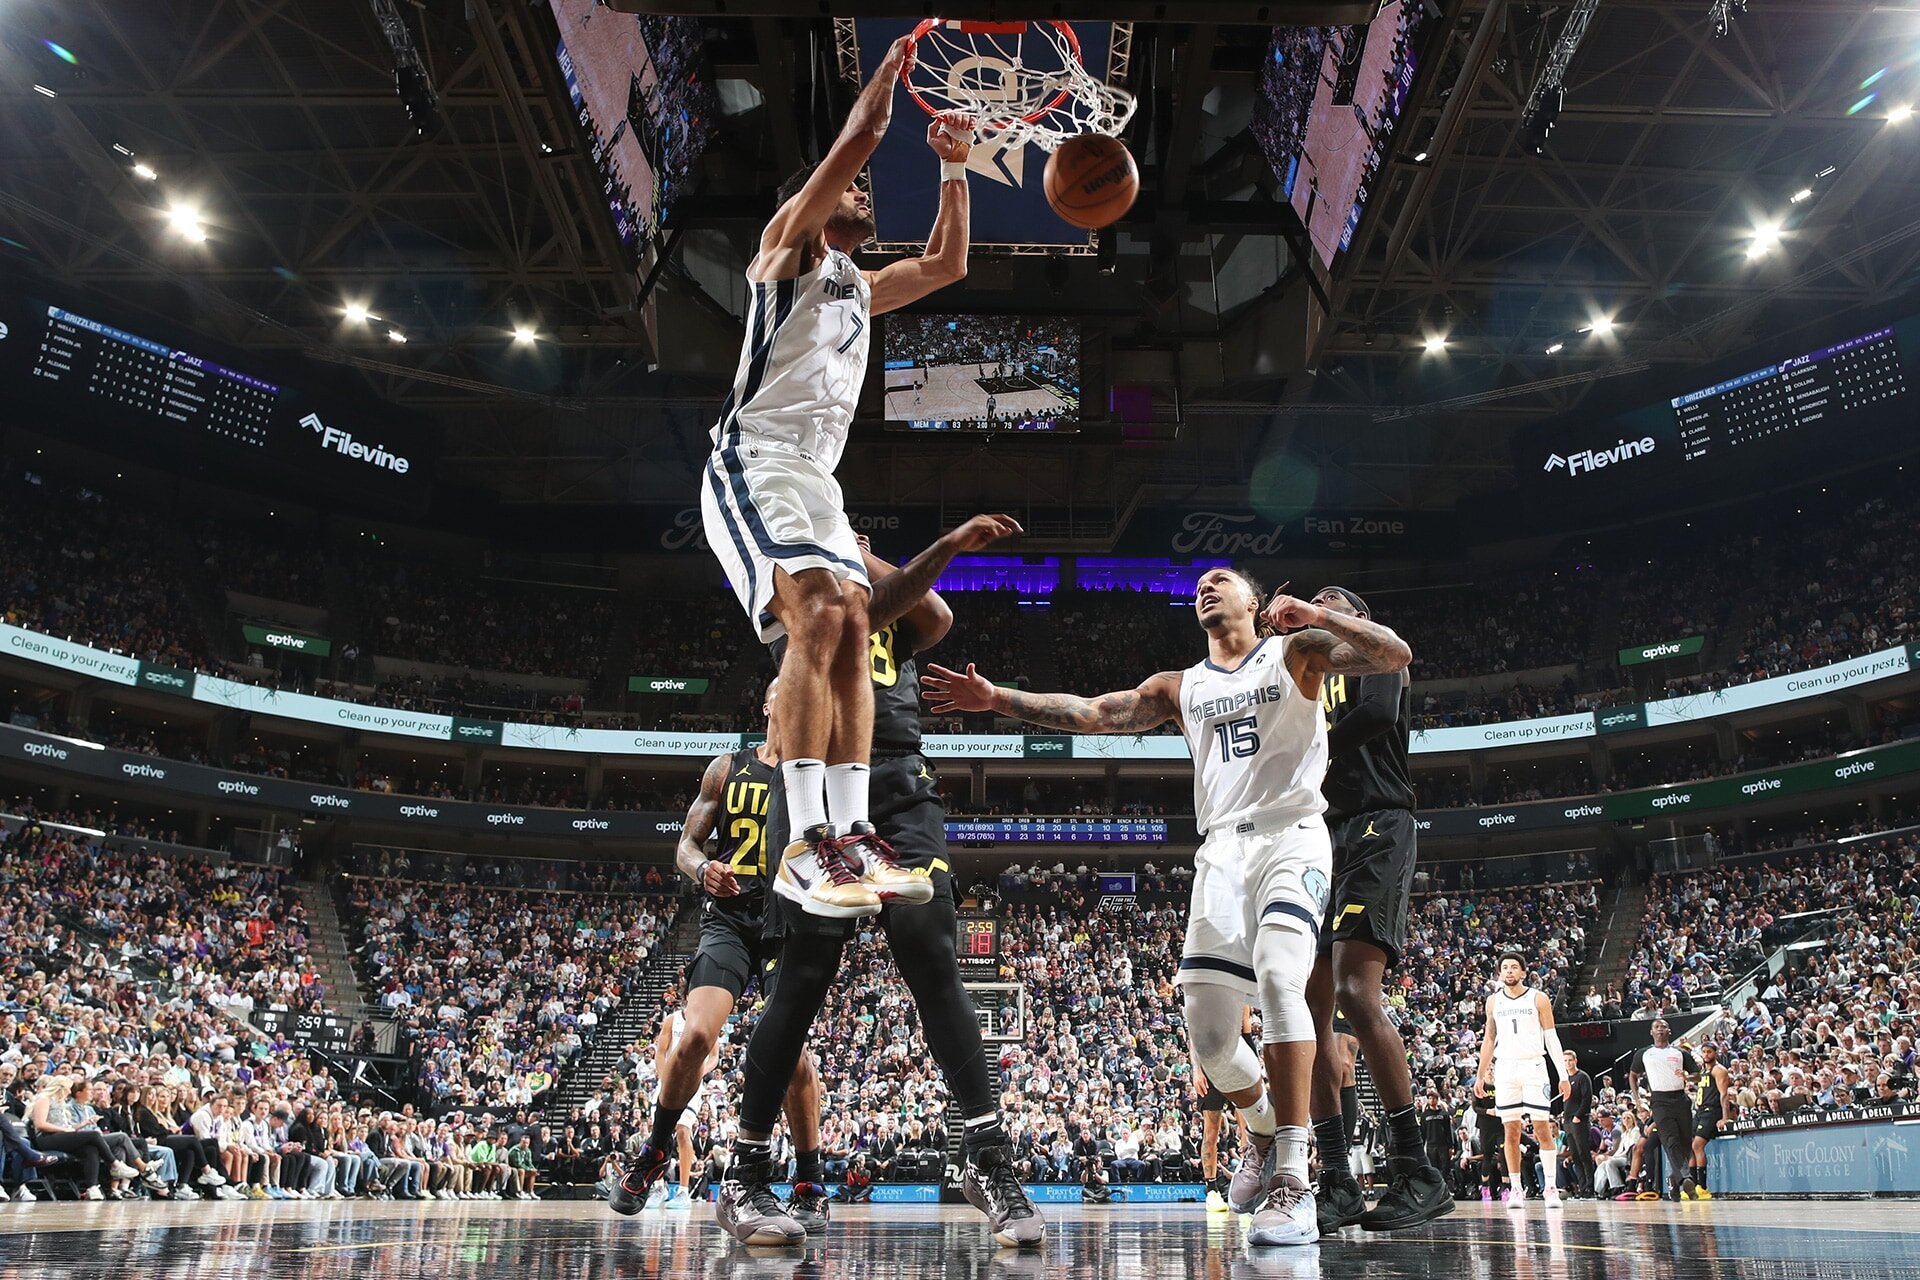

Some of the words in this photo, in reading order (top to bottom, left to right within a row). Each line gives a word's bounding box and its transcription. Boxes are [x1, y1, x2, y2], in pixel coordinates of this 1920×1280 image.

[1383, 117, 1394, 135] 79
[1358, 185, 1369, 202] 83
[57, 323, 76, 334] WELLS
[64, 313, 102, 332] GRIZZLIES
[837, 311, 864, 354] 7
[50, 347, 72, 358] CLARKE
[47, 360, 71, 371] ALDAMA
[185, 355, 203, 367] JAZZ
[1792, 355, 1810, 367] JAZZ
[1790, 365, 1818, 377] CLARKSON
[1793, 378, 1815, 389] COLLINS
[1684, 386, 1716, 403] GRIZZLIES
[1796, 385, 1830, 400] SENSABAUGH
[1683, 404, 1699, 413] WELLS
[1799, 398, 1828, 411] HENDRICKS
[1037, 421, 1050, 429] UTA
[1685, 415, 1702, 424] PIPPEN
[1802, 412, 1823, 423] GEORGE
[1688, 425, 1706, 435] CLARKE
[1691, 436, 1711, 446] ALDAMA
[321, 426, 409, 474] Filevine
[1567, 435, 1656, 477] Filevine
[1171, 511, 1285, 555] Ford
[1304, 517, 1344, 534] Fan
[1350, 517, 1404, 534] Zone
[266, 633, 306, 649] aptive
[10, 635, 50, 655] Clean
[51, 646, 69, 661] up
[71, 652, 99, 669] your
[100, 660, 126, 676] pest
[1642, 643, 1681, 659] aptive
[146, 670, 185, 688] aptive
[1787, 676, 1823, 692] Clean
[1825, 672, 1840, 685] up
[1842, 665, 1869, 681] your
[1871, 658, 1895, 674] pest
[650, 678, 686, 692] aptive
[1191, 685, 1281, 724] MEMPHIS
[338, 708, 370, 722] Clean
[373, 715, 389, 729] up
[390, 719, 416, 732] your
[418, 722, 440, 735] pest
[1601, 713, 1637, 728] aptive
[459, 724, 494, 738] aptive
[1484, 729, 1516, 741] Clean
[1519, 727, 1533, 740] up
[1535, 724, 1560, 738] your
[1562, 722, 1584, 734] pest
[634, 737, 665, 748] Clean
[667, 739, 682, 752] up
[683, 740, 707, 752] your
[709, 742, 730, 751] pest
[1214, 715, 1260, 763] 15
[23, 741, 68, 760] aptive
[951, 743, 965, 754] up
[967, 743, 991, 754] your
[992, 743, 1013, 752] pest
[1030, 742, 1064, 752] aptive
[122, 762, 165, 779] aptive
[1834, 760, 1876, 780] aptive
[217, 780, 259, 796] aptive
[1741, 778, 1783, 796] aptive
[310, 794, 350, 808] aptive
[1651, 793, 1692, 809] aptive
[399, 804, 440, 818] aptive
[1564, 804, 1603, 820] aptive
[486, 812, 525, 826] aptive
[572, 818, 609, 831] aptive
[655, 820, 686, 833] aptiv
[1478, 814, 1517, 829] aptive
[958, 824, 974, 832] 11/16
[975, 824, 994, 832] (69%)
[1003, 824, 1011, 832] 10
[1020, 824, 1028, 832] 18
[1036, 824, 1045, 832] 28
[1052, 824, 1062, 832] 20
[1071, 824, 1076, 832] 6
[1087, 824, 1093, 832] 3
[1103, 824, 1111, 832] 10
[1120, 824, 1129, 832] 25
[1135, 824, 1146, 832] 114
[1151, 824, 1163, 832] 105
[957, 833, 975, 841] 19/25
[976, 833, 995, 841] (76%)
[1005, 833, 1010, 841] 8
[1020, 833, 1029, 841] 23
[1036, 833, 1045, 841] 31
[1053, 833, 1061, 841] 14
[1071, 833, 1077, 841] 6
[1088, 833, 1093, 841] 7
[1104, 833, 1111, 841] 13
[1121, 833, 1129, 841] 18
[1135, 833, 1147, 841] 105
[1152, 833, 1163, 841] 114
[967, 921, 993, 933] 2:59
[971, 933, 991, 955] 18
[1497, 1008, 1533, 1017] MEMPHIS
[264, 1022, 277, 1032] 83
[333, 1027, 344, 1037] 79
[1511, 1019, 1518, 1034] 1
[1766, 1117, 1785, 1126] DELTA
[1797, 1113, 1818, 1123] DELTA
[1831, 1110, 1854, 1120] DELTA
[1868, 1106, 1893, 1117] DELTA
[1774, 1144, 1804, 1165] FIRST
[1804, 1141, 1856, 1163] COLONY
[1778, 1164, 1851, 1178] MORTGAGE
[1046, 1186, 1068, 1194] FIRST
[1145, 1187, 1167, 1195] FIRST
[1167, 1186, 1200, 1195] COLONY
